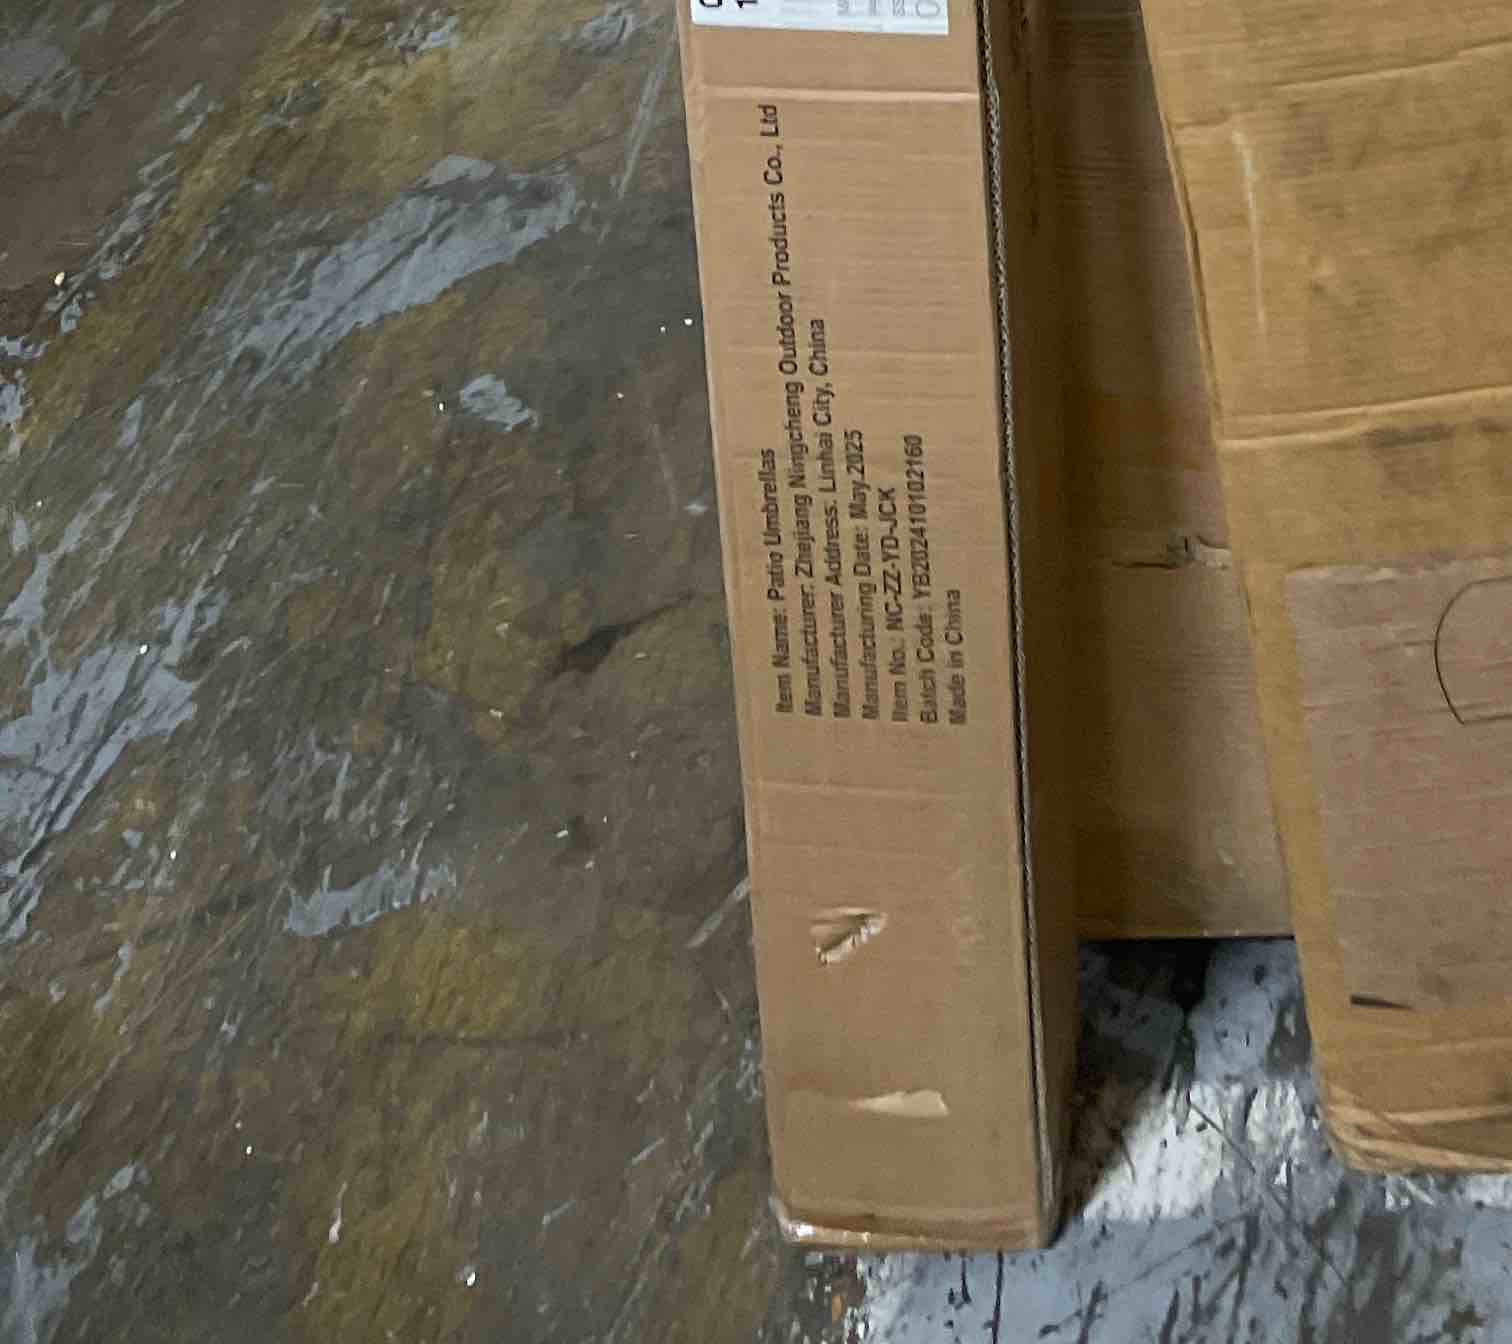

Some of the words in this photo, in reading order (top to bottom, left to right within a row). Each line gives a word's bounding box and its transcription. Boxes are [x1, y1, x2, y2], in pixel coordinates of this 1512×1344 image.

[758, 104, 779, 137] Ltd
[763, 145, 784, 185] Co.,
[768, 192, 790, 286] Products
[776, 291, 798, 375] Outdoor
[808, 318, 829, 376] China
[813, 382, 836, 426] City,
[784, 381, 808, 489] Ningcheng
[816, 432, 837, 493] Linhai
[758, 448, 782, 546] Umbrellas
[793, 494, 815, 578] Zhejiang
[821, 500, 843, 586] Address:
[852, 527, 872, 576] Date:
[878, 487, 902, 630] NC-ZZ-YD-JCK
[765, 552, 786, 601] Patio
[771, 608, 791, 669] Name:
[916, 607, 935, 662] Code:
[943, 589, 963, 645] China
[801, 582, 824, 717] Manufacturer:
[829, 592, 851, 718] Manufacturer
[858, 582, 880, 719] Manufacturing
[944, 650, 964, 669] in
[775, 674, 794, 713] Item
[891, 681, 910, 722] Item
[919, 668, 939, 724] Batch
[947, 673, 968, 724] Made
